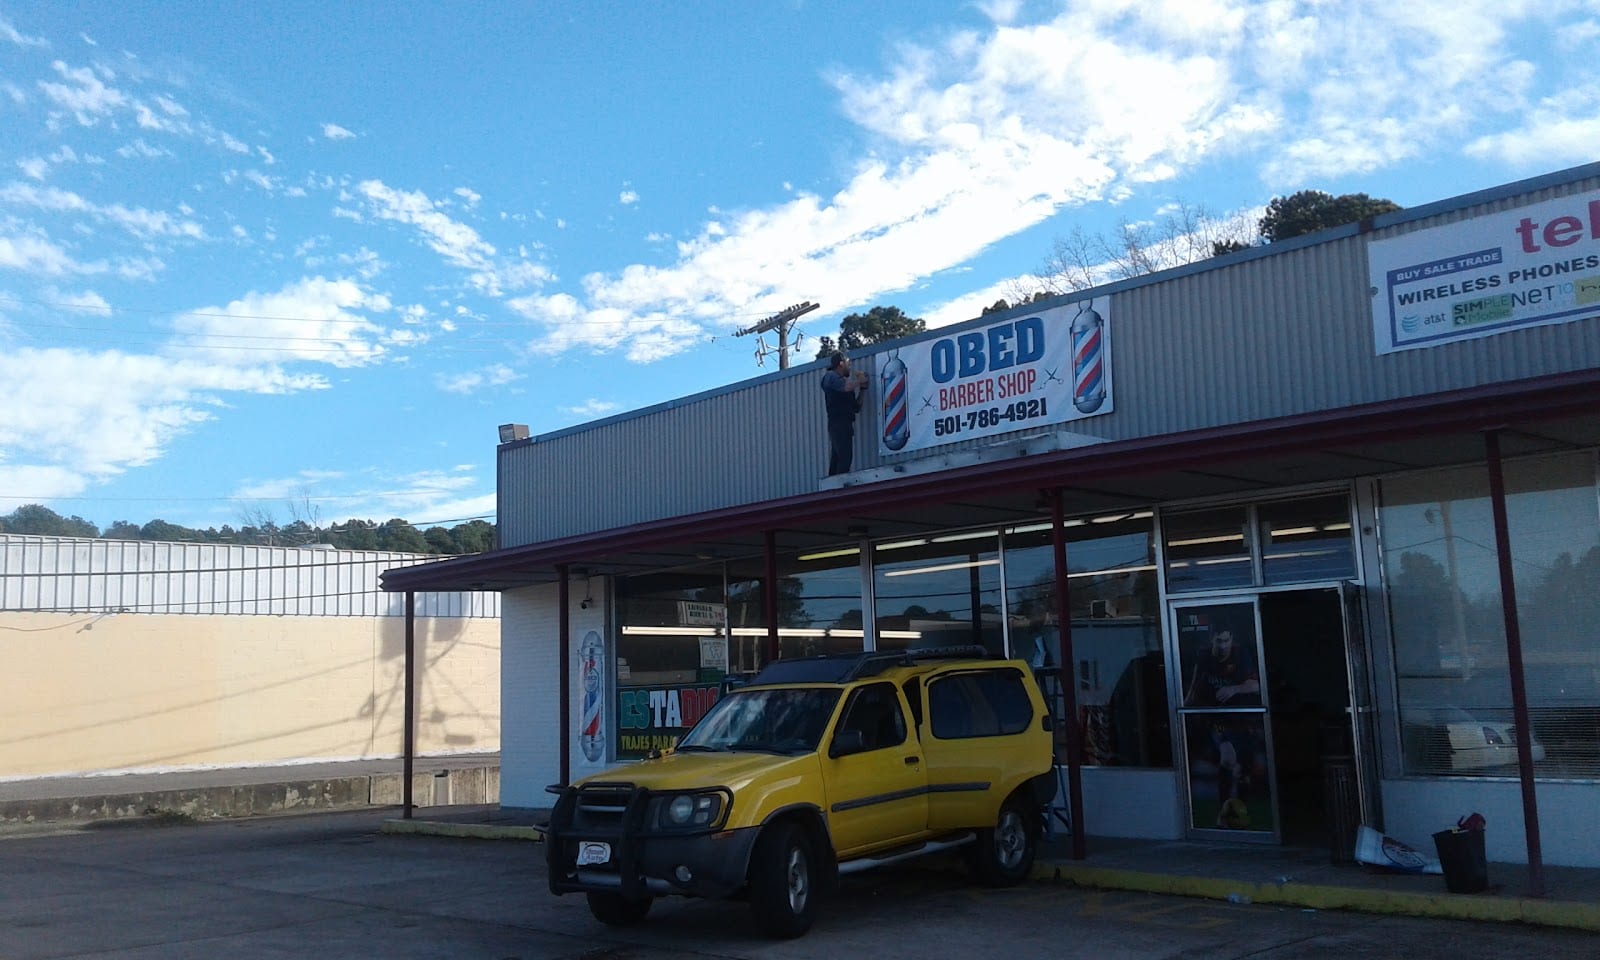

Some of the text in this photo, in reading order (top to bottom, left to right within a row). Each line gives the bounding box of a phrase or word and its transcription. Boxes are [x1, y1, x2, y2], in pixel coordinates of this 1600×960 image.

[1396, 252, 1500, 281] BUY SALE TRADE
[1397, 255, 1599, 306] WIRELESS PHONES
[1423, 312, 1447, 326] at&t
[1454, 297, 1512, 315] SIMPLE
[930, 317, 1045, 384] OBED
[939, 368, 1037, 411] BARBER SHOP
[934, 397, 1048, 437] 501-786-4921
[621, 735, 650, 750] TRAJES
